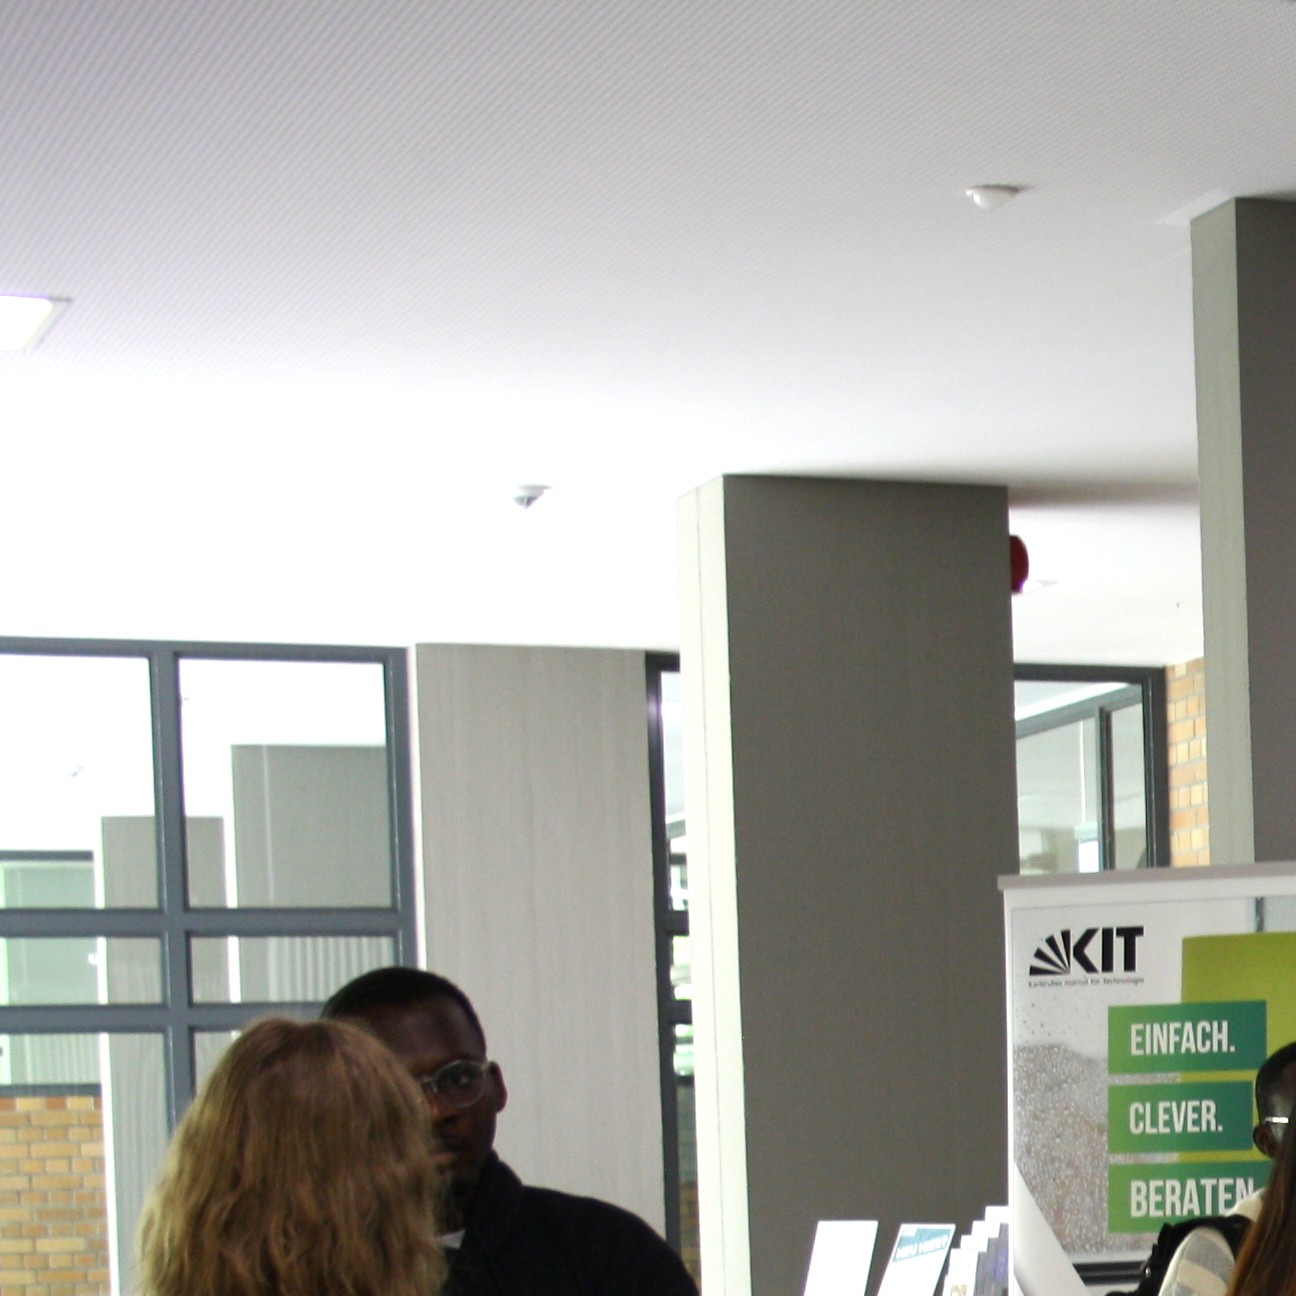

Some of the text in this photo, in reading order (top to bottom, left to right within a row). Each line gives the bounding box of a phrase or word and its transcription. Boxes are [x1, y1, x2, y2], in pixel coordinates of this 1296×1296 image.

[1061, 925, 1145, 974] KIT
[1130, 1019, 1236, 1057] EINFACH.
[1129, 1100, 1224, 1135] CLEVER.
